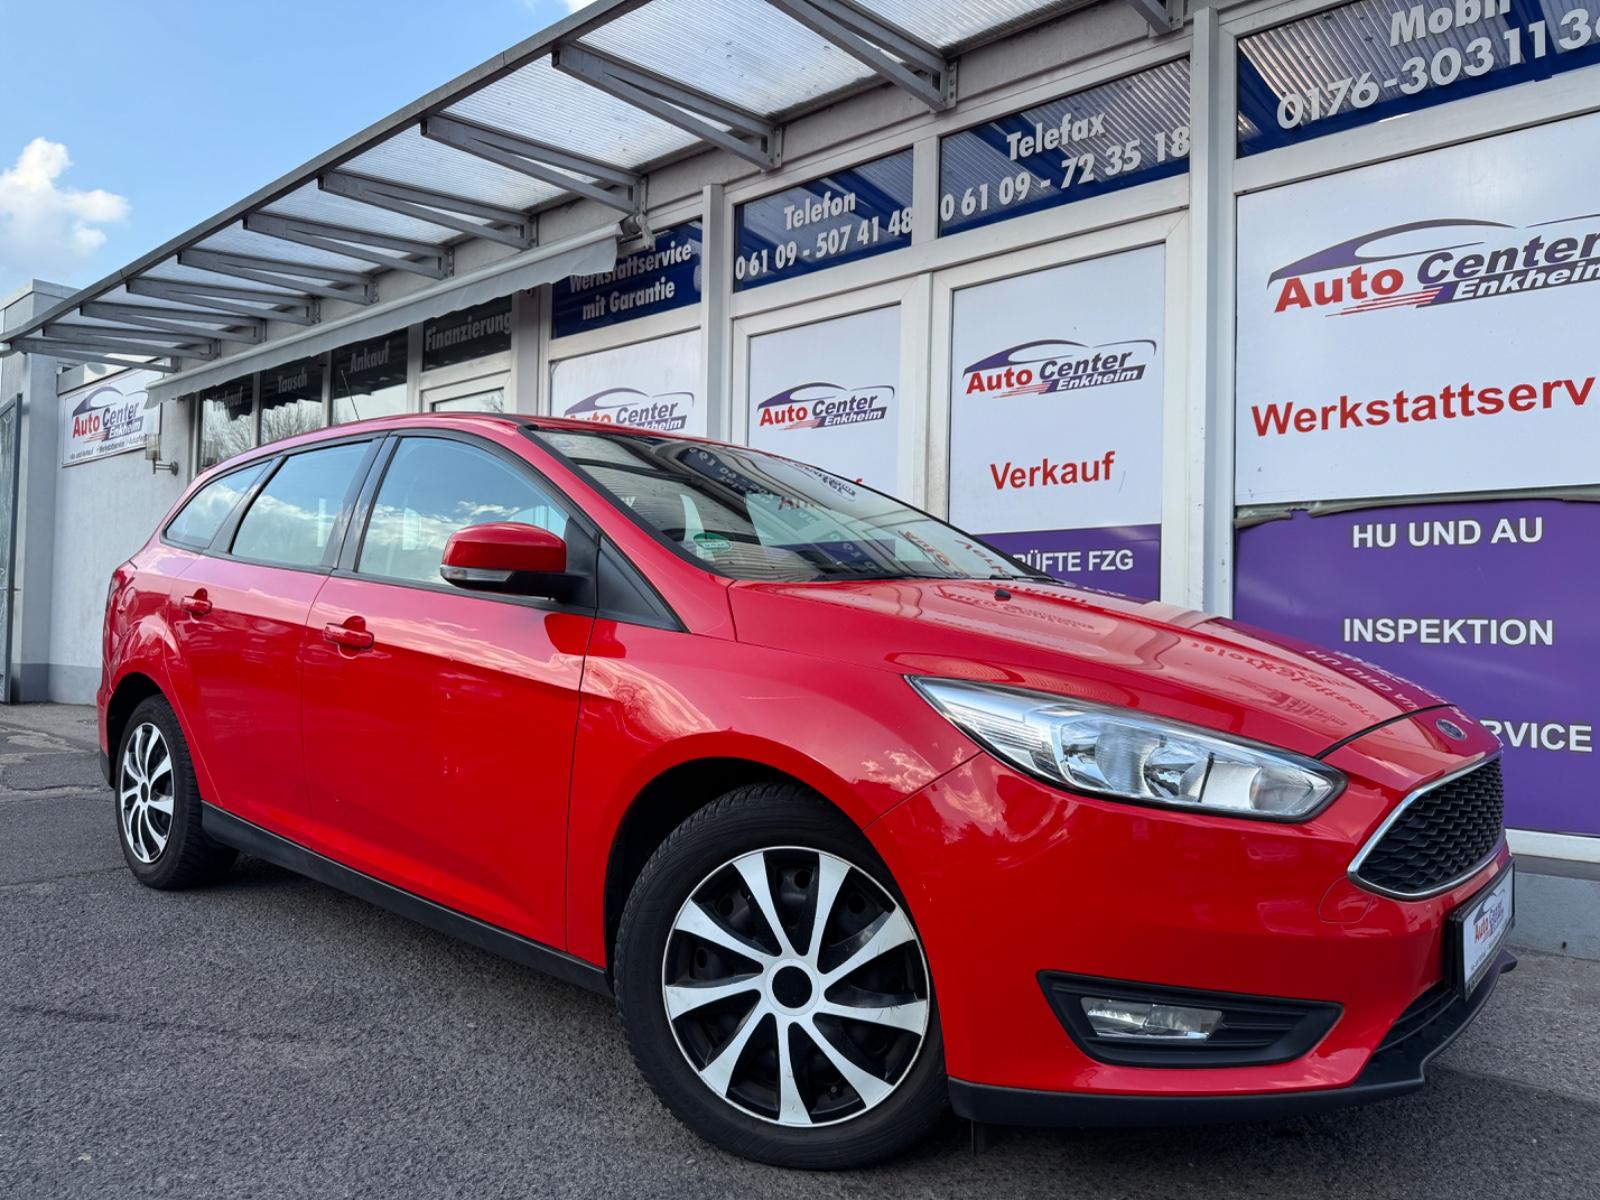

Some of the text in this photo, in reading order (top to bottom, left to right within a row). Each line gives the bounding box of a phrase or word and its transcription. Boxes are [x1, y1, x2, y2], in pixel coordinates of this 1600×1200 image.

[1006, 112, 1106, 161] Telefax
[999, 172, 1031, 205] 09
[1061, 153, 1095, 189] 72
[1105, 140, 1141, 176] 35
[1155, 126, 1190, 162] 18
[784, 191, 856, 231] Telefon
[775, 241, 797, 269] 09
[815, 225, 852, 258] 507
[857, 216, 879, 245] 41
[888, 206, 912, 237] 48
[1274, 232, 1600, 313] Auto Center
[582, 277, 676, 321] mit Garantie
[425, 311, 513, 351] Finanzierung
[350, 341, 391, 373] Ankauf
[966, 352, 1133, 394] Auto Center
[277, 367, 308, 393] Tausch
[1056, 368, 1139, 391] Enkheim
[73, 402, 139, 439] Auto Center
[569, 402, 679, 424] to Center
[760, 395, 878, 427] Auto Center
[824, 409, 882, 426] Enkheim
[1251, 377, 1596, 437] Werkstattserv
[990, 451, 1115, 490] Verkauf
[1353, 517, 1543, 548] HU UND AU
[1088, 550, 1133, 572] FZG
[1343, 618, 1553, 645] INSPEKTION
